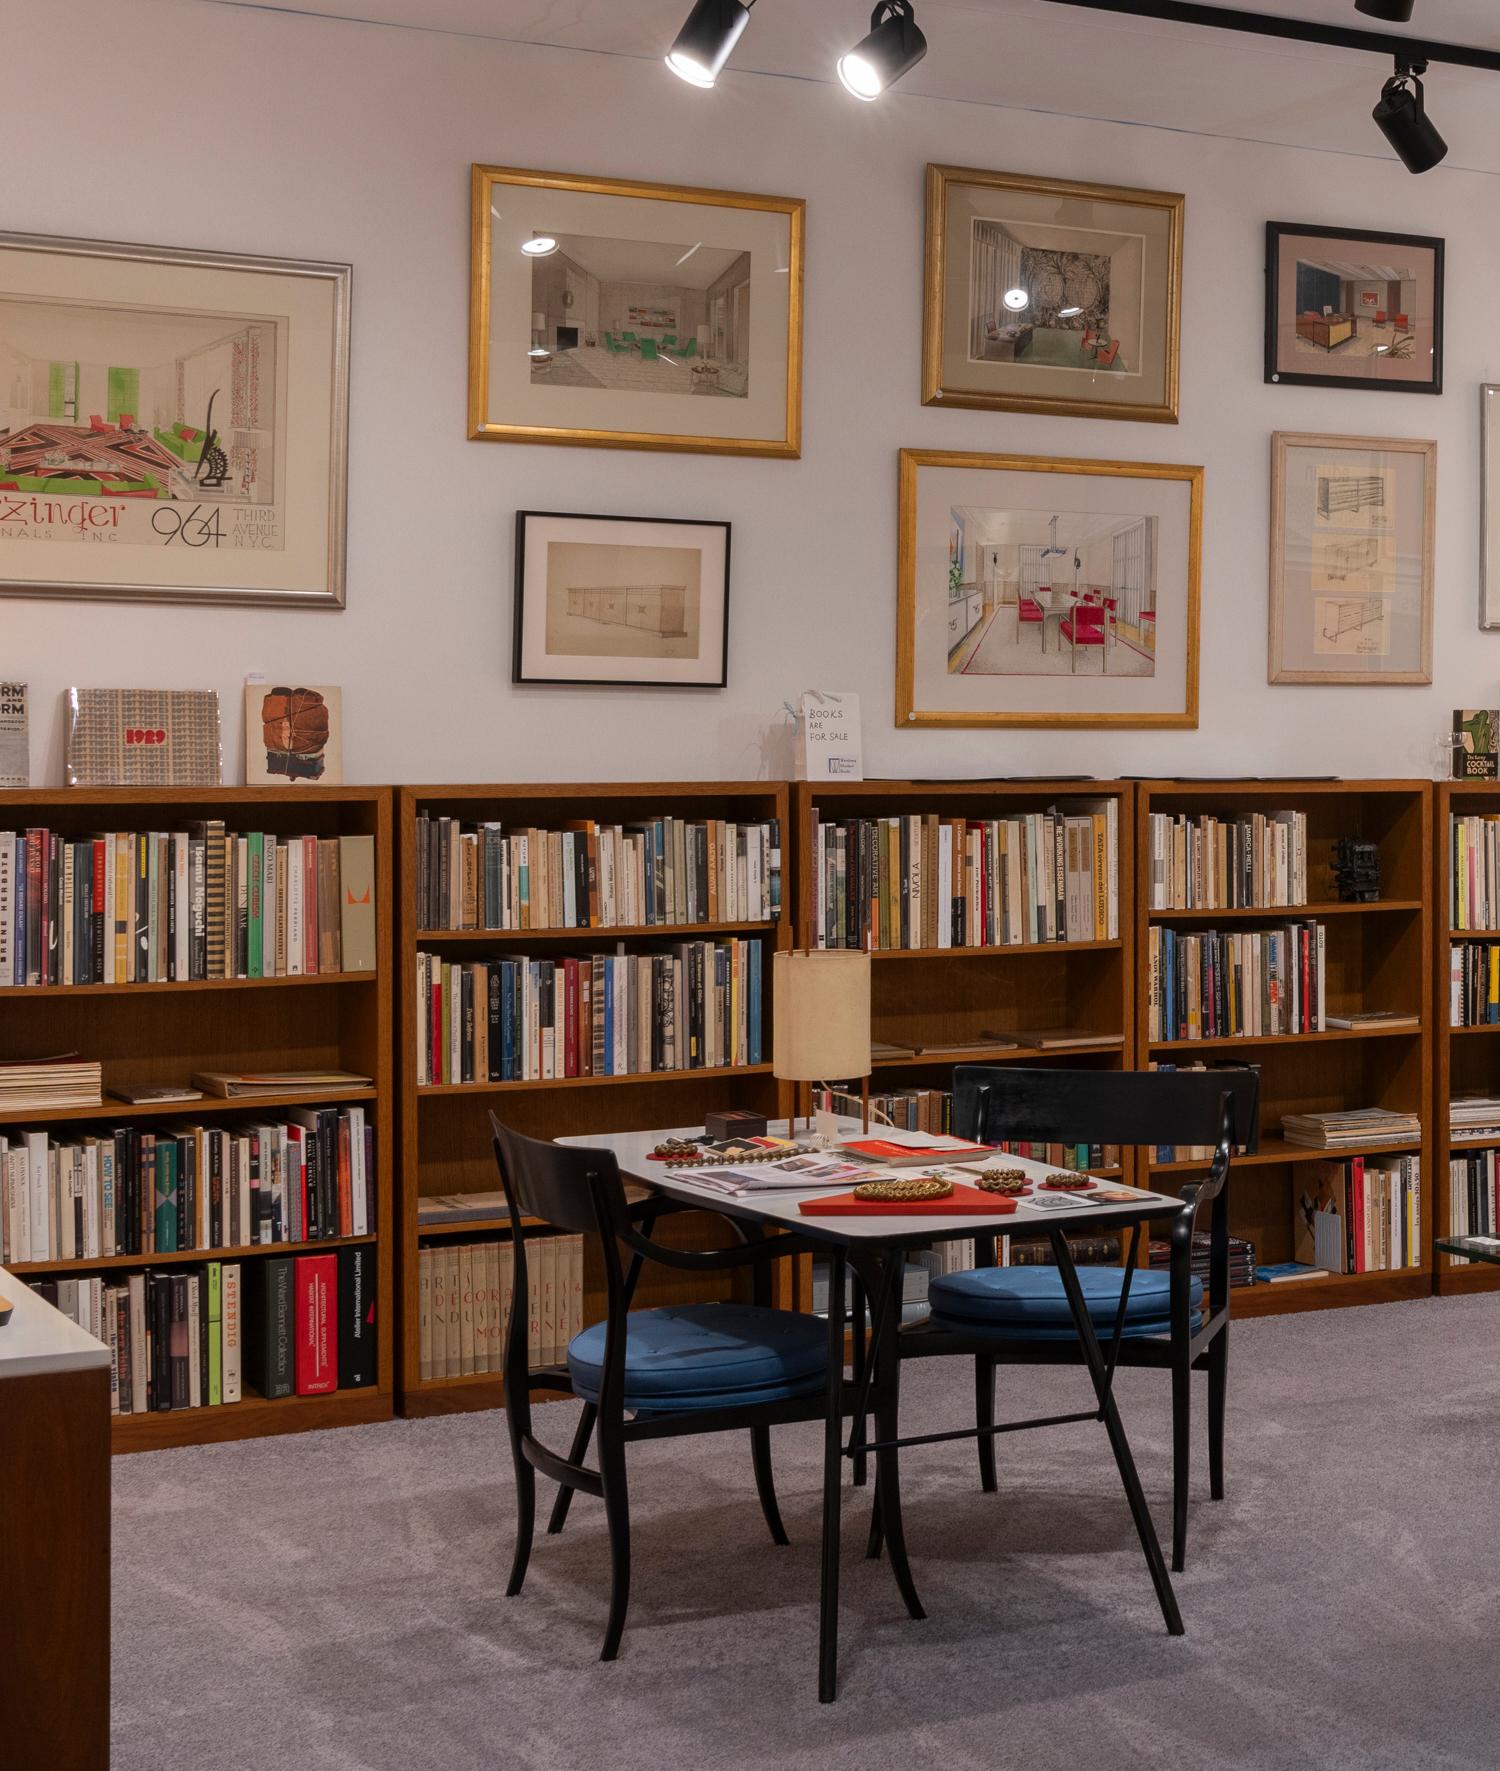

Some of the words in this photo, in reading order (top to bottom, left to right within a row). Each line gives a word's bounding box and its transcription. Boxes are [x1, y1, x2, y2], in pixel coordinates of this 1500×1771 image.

[0, 496, 126, 532] zinger
[151, 505, 227, 549] 964
[232, 508, 275, 525] THIRD
[232, 523, 278, 538] AVENUE
[809, 708, 844, 719] BOOKS
[809, 721, 823, 729] ARE
[126, 729, 166, 744] 1929
[810, 733, 828, 742] FOR
[829, 733, 849, 742] SALE
[1466, 760, 1495, 768] COCKTAIL
[1466, 767, 1490, 775] BOOK
[1056, 825, 1065, 867] RE:WORKING
[1097, 832, 1105, 854] TATA
[194, 846, 205, 883] Isamu
[871, 881, 880, 898] ART
[1056, 867, 1064, 901] EISENMAN
[192, 887, 205, 937] Noguchi
[1097, 894, 1105, 926] LUDICO
[103, 1154, 113, 1178] HOW
[103, 1179, 113, 1191] TO
[103, 1192, 113, 1209] SEE
[277, 1266, 288, 1283] The
[354, 1251, 362, 1277] Limited
[277, 1282, 288, 1304] Ward
[354, 1277, 362, 1318] International
[118, 1311, 127, 1327] the
[226, 1281, 237, 1348] STENDIG
[277, 1305, 288, 1335] Bennett
[118, 1329, 126, 1346] new
[354, 1318, 362, 1339] Atelier
[118, 1350, 127, 1380] vision
[277, 1336, 288, 1375] Collection
